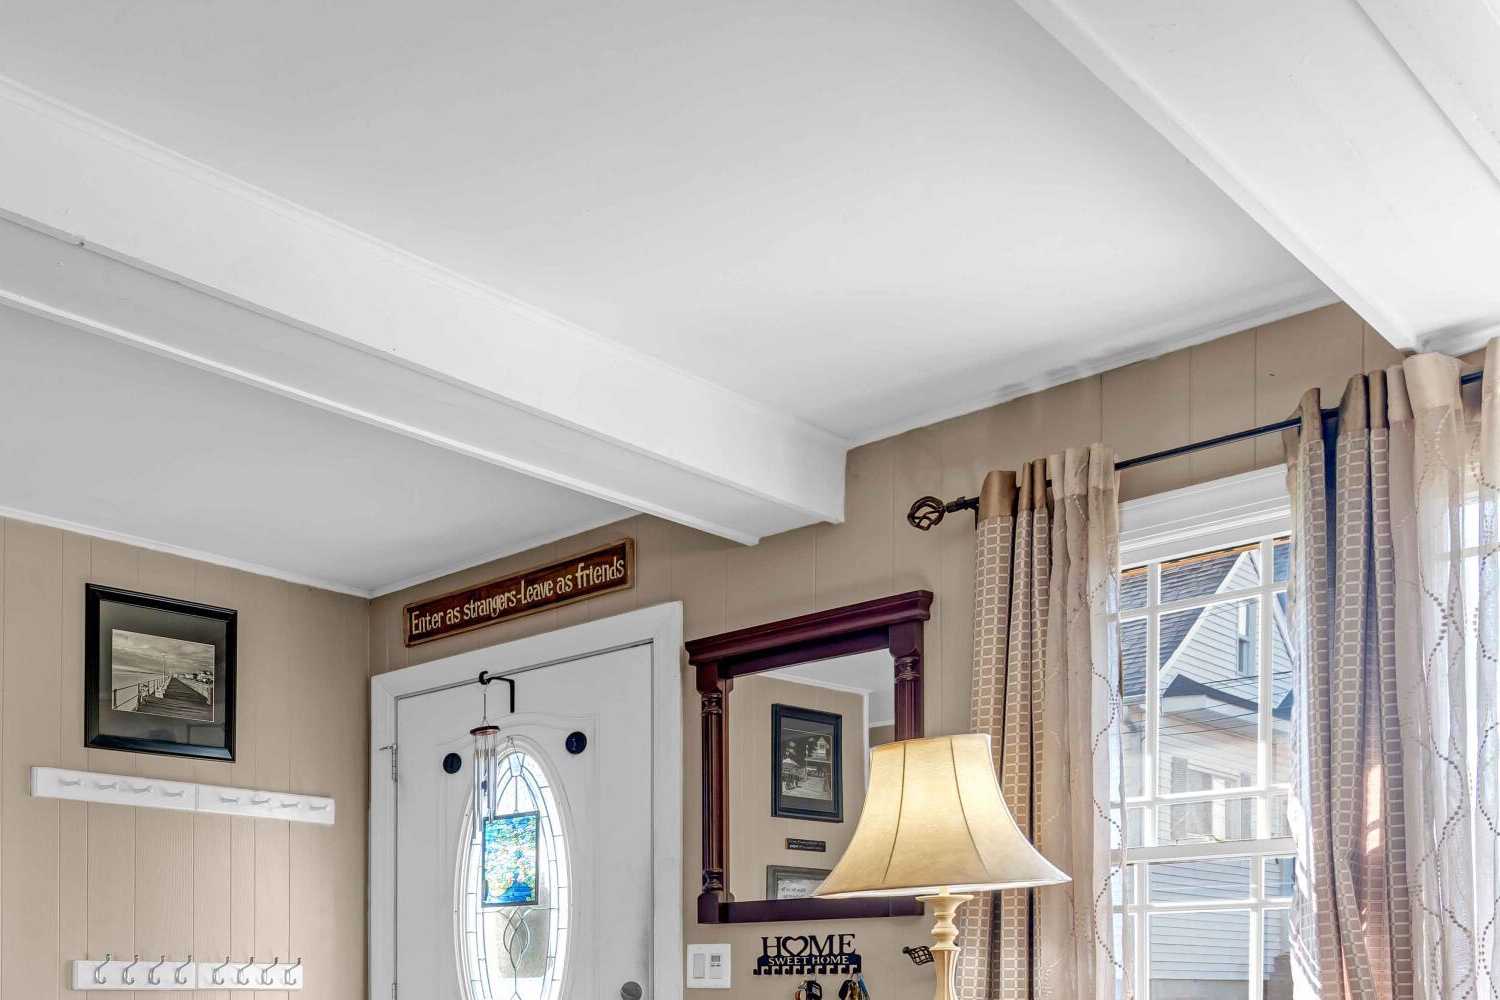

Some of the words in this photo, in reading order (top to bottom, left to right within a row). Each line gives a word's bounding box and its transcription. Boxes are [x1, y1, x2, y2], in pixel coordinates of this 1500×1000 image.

[411, 610, 444, 635] Enter
[445, 606, 461, 625] as
[556, 574, 573, 594] as
[575, 555, 625, 589] friends
[768, 956, 809, 966] SWEET
[812, 955, 850, 965] HOME
